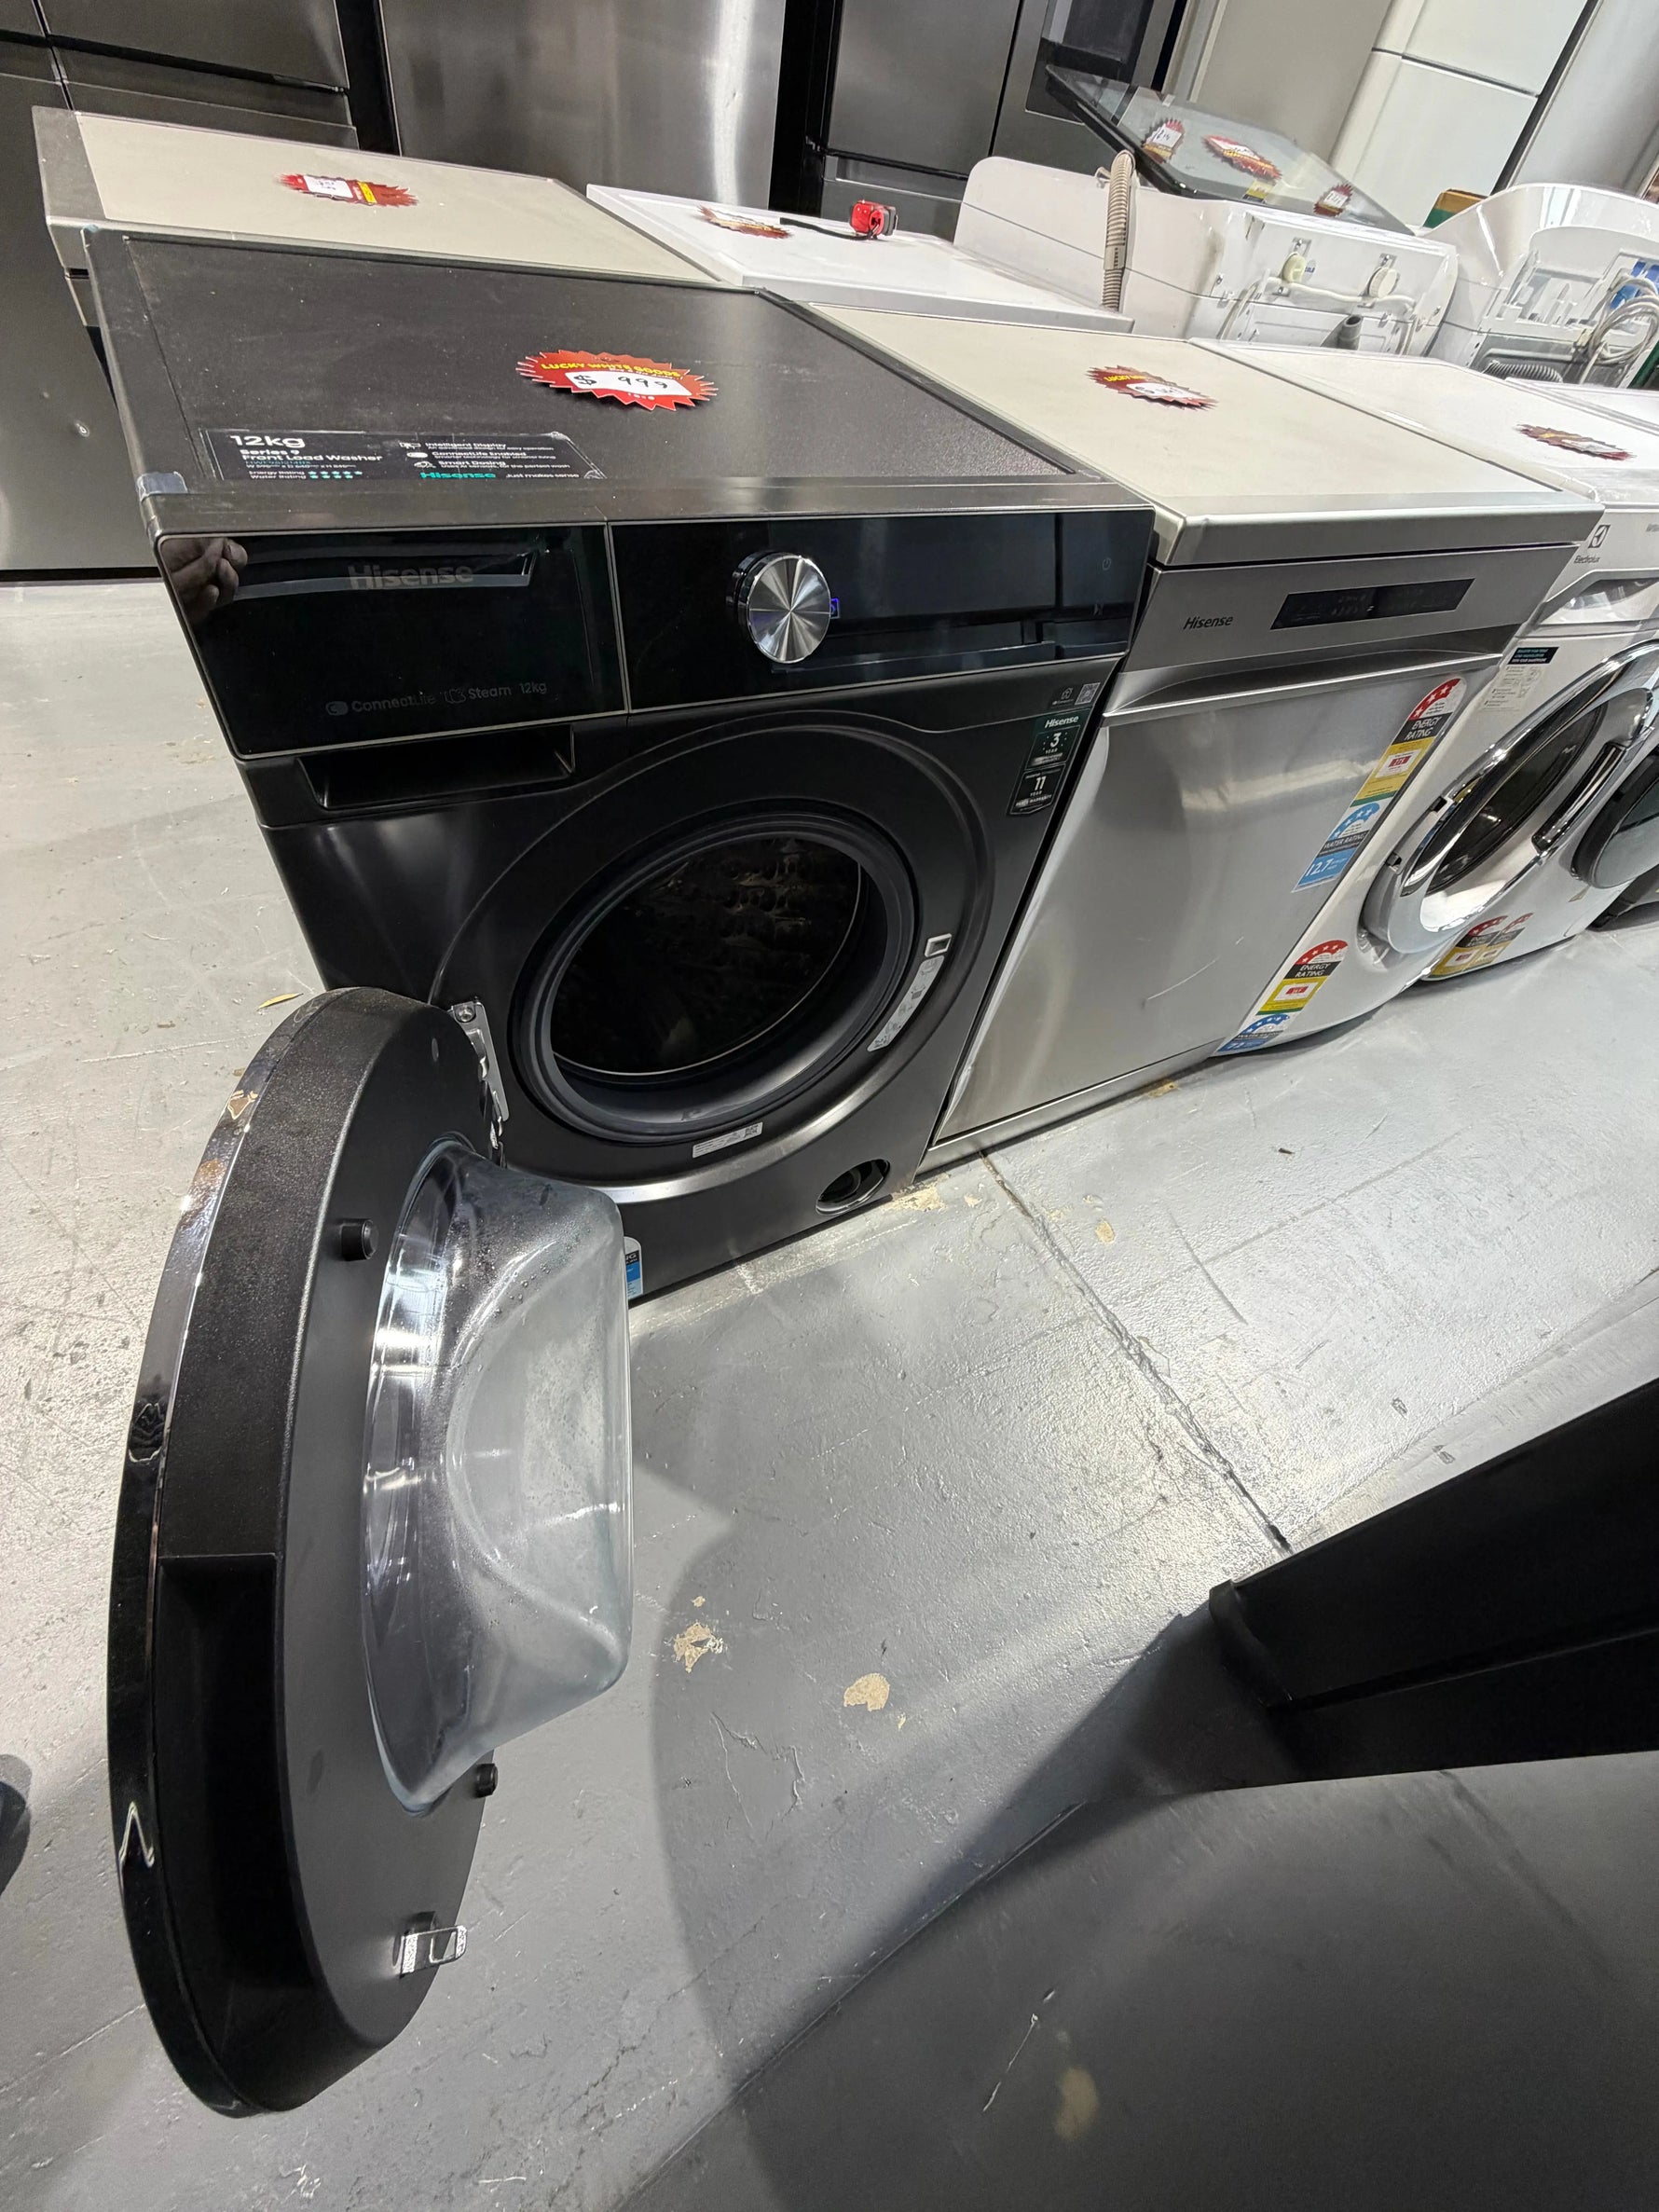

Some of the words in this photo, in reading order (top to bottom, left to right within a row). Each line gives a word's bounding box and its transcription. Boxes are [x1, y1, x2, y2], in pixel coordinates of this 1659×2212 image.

[634, 365, 681, 378] GOODS
[573, 375, 597, 386] $
[618, 376, 667, 389] 999
[230, 435, 306, 448] 12kg
[348, 564, 474, 590] Hisense
[1183, 614, 1234, 631] Hisense
[468, 686, 513, 700] Steam
[519, 681, 548, 694] 12kg
[1044, 715, 1079, 729] Hisense
[1411, 716, 1441, 731] ENERGY
[1049, 732, 1063, 748] 3
[1404, 727, 1433, 741] RATING
[1034, 776, 1047, 791] 11
[1295, 969, 1325, 978] RATING
[1299, 963, 1331, 971] ENERGY
